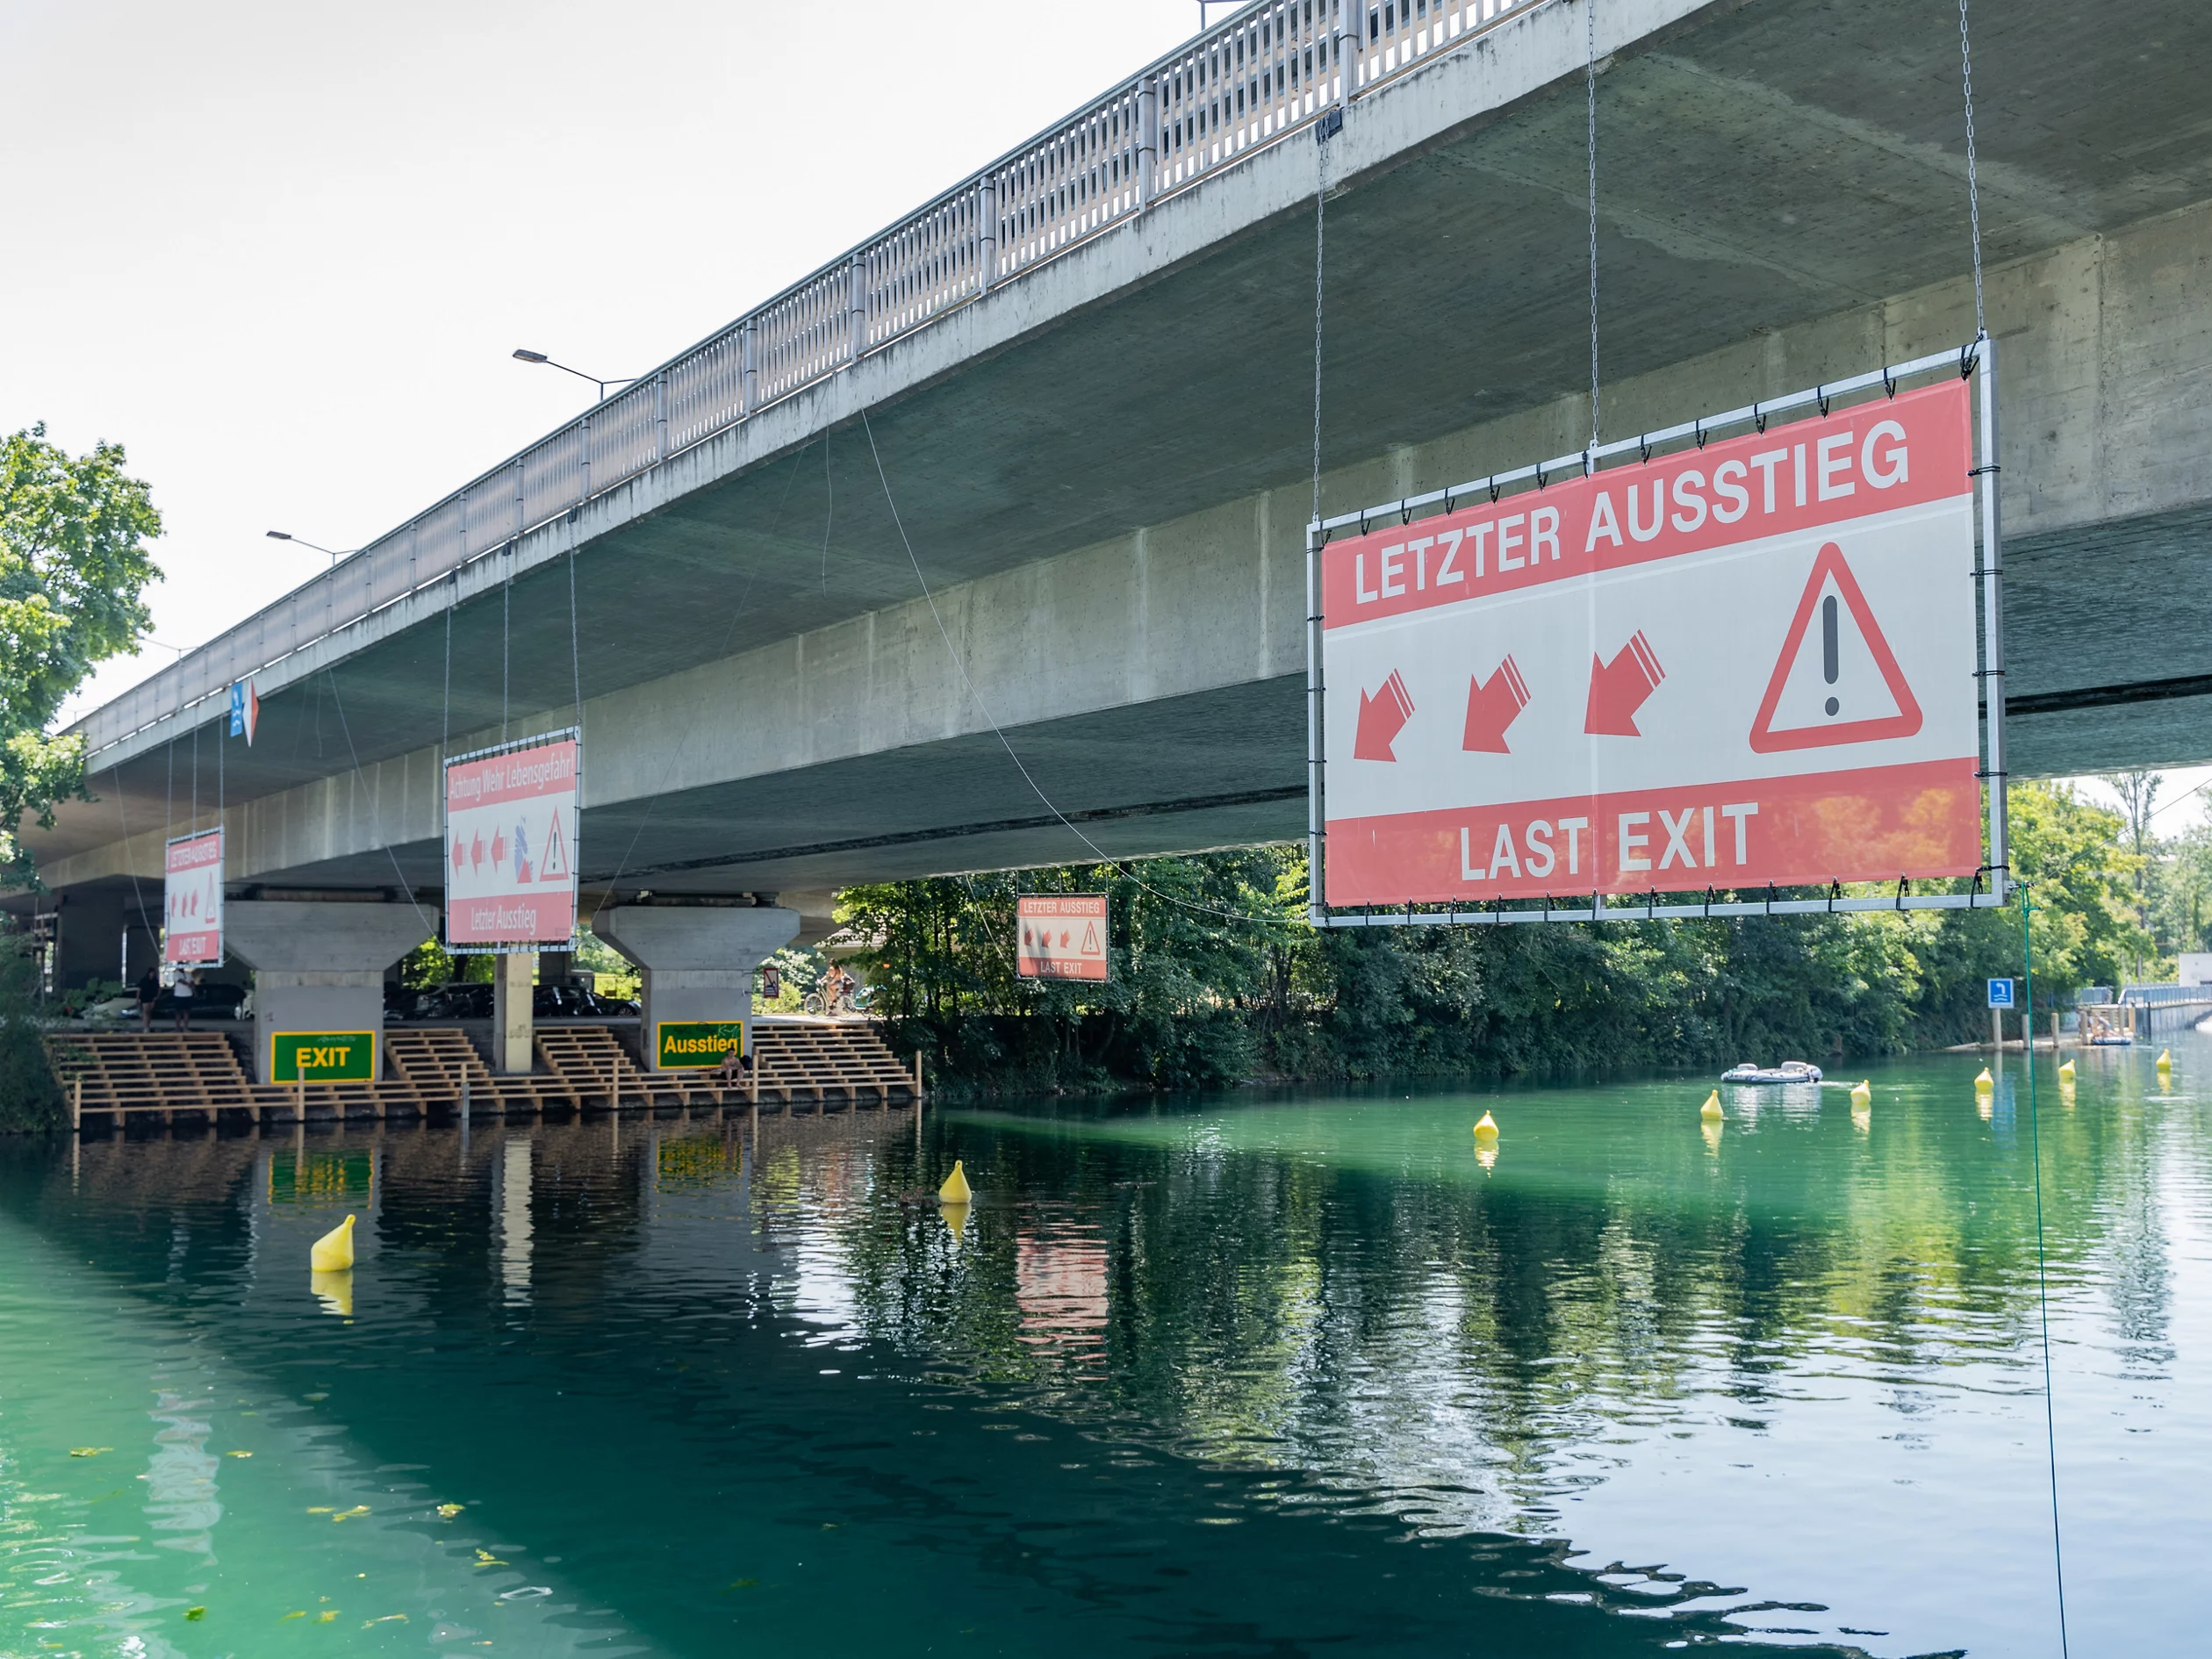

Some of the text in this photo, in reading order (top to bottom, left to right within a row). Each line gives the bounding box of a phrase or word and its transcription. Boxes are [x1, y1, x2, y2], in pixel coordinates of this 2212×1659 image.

[1354, 420, 1910, 605] LETZTER AUSSTIEG
[449, 750, 575, 801] Achtung Wehr Lebensgefahr!
[1460, 801, 1761, 882] LAST EXIT
[470, 902, 537, 937] Letzter Ausstieg
[1023, 901, 1100, 914] LETZTER AUSSTIEG
[1040, 961, 1082, 974] LAST EXIT
[296, 1046, 351, 1068] EXIT
[664, 1034, 738, 1056] Ausstieg
